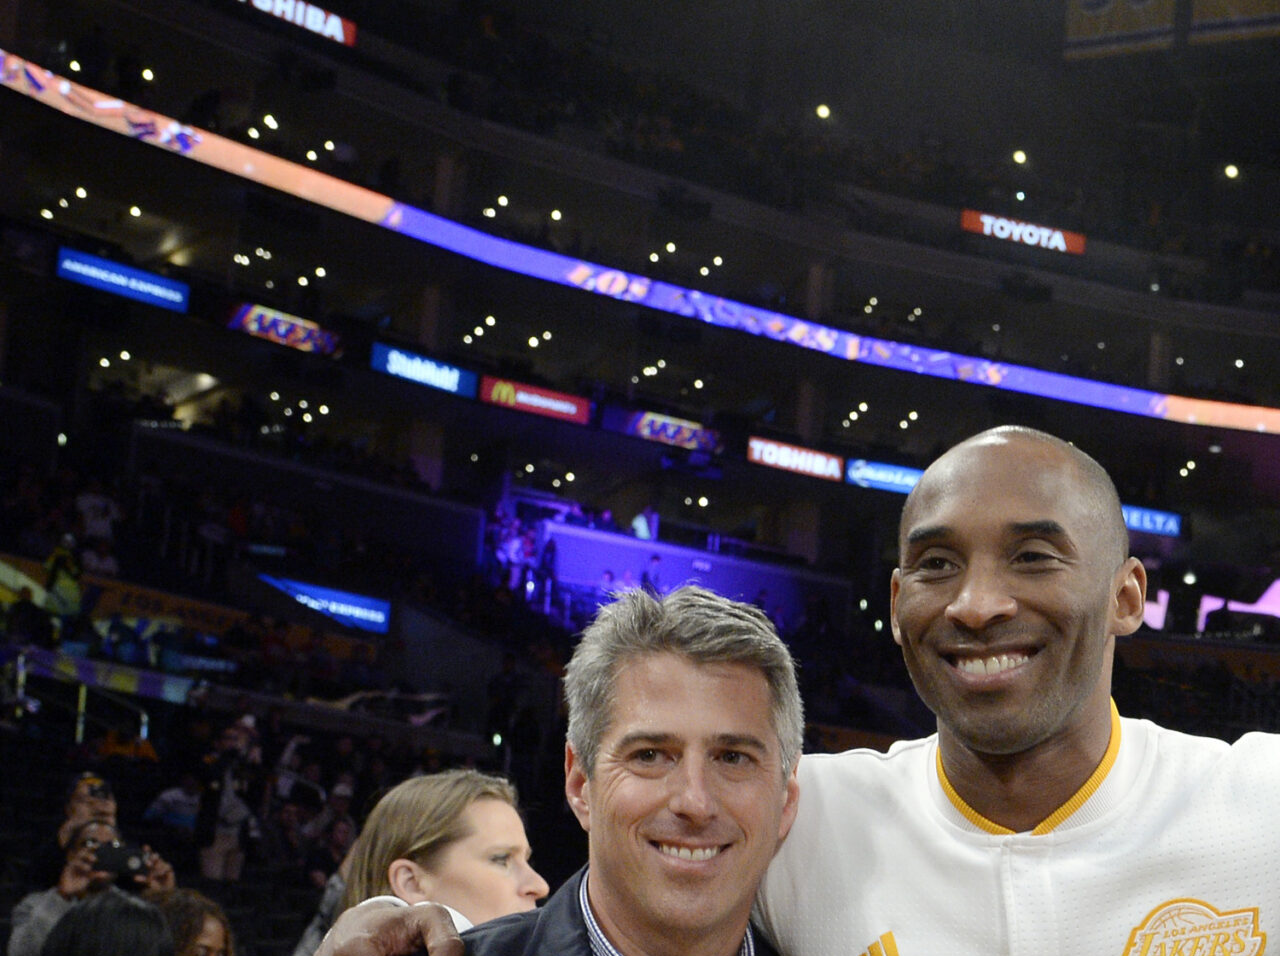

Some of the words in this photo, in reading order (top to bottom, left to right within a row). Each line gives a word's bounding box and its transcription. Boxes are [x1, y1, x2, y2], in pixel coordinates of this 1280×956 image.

[238, 0, 345, 42] SHIBA
[980, 213, 1067, 252] TOYOTA
[750, 439, 843, 478] TOSHIBA
[1163, 927, 1187, 938] LOS
[1188, 917, 1249, 933] ANGELES
